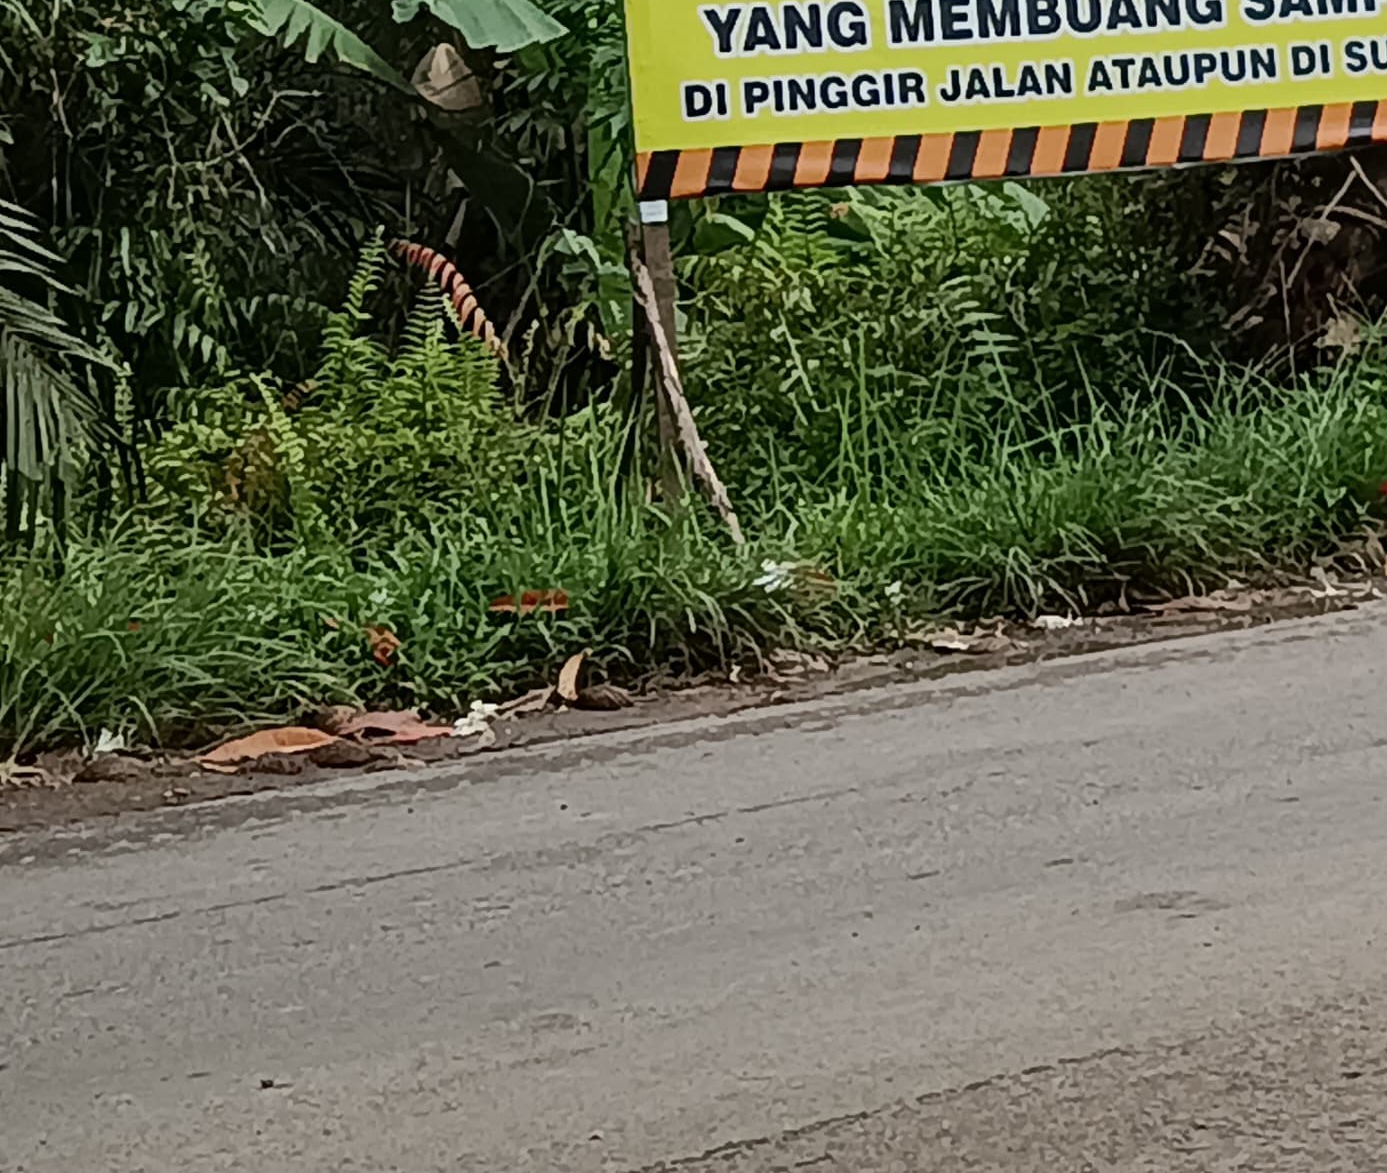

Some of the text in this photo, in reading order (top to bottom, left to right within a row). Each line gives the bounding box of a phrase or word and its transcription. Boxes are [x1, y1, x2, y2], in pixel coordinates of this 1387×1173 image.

[704, 0, 868, 54] YANG
[683, 82, 729, 119] DI
[742, 71, 926, 115] PINGGIR
[939, 61, 1074, 103] JALAN
[1087, 47, 1278, 93] ATAUPUN
[1290, 43, 1331, 77] DI
